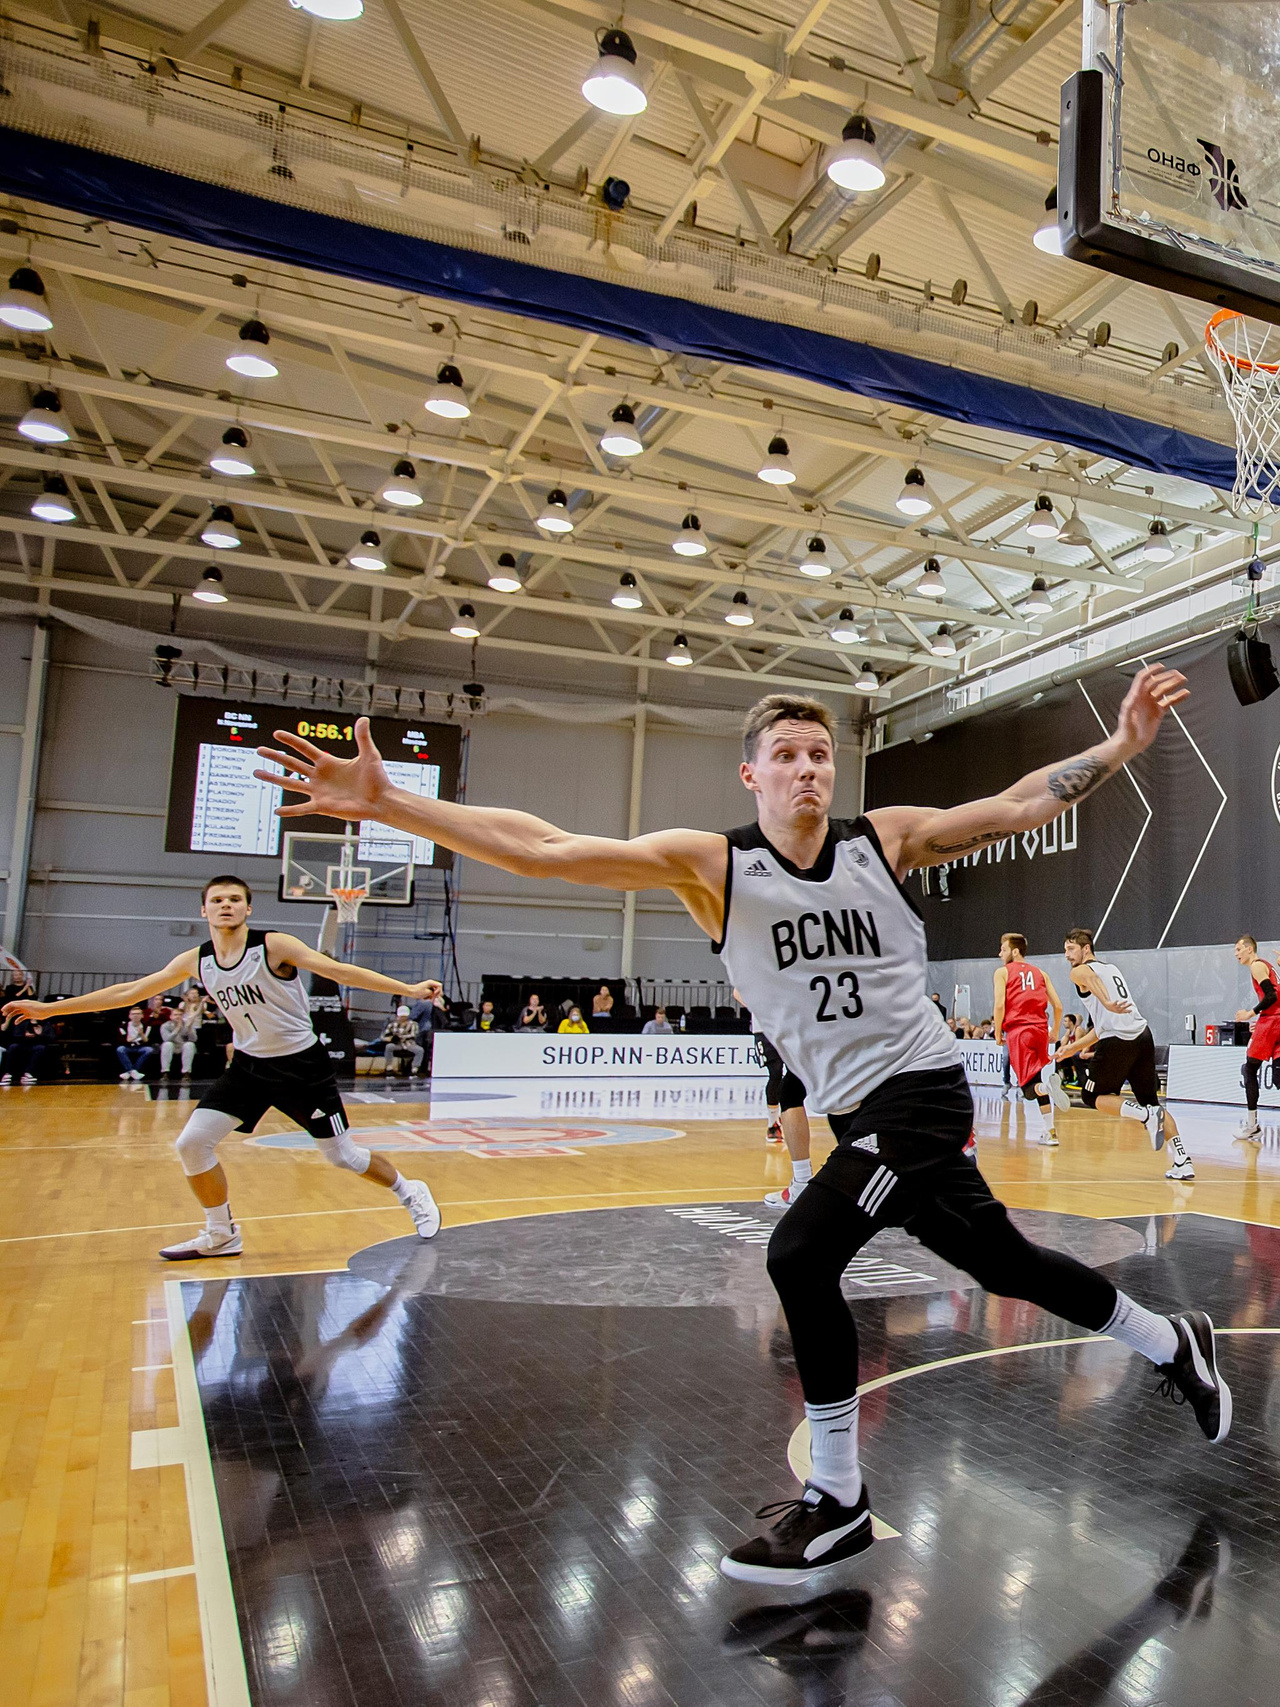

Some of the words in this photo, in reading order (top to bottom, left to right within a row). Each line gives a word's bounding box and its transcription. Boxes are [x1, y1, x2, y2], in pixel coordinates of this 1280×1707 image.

[297, 721, 353, 741] 0:56.1
[771, 908, 882, 971] BCNN
[1020, 970, 1035, 991] 14
[1112, 975, 1129, 1000] 8
[216, 984, 266, 1012] BCNN
[809, 971, 863, 1022] 23
[244, 1012, 258, 1032] 1
[1206, 1029, 1214, 1044] 5
